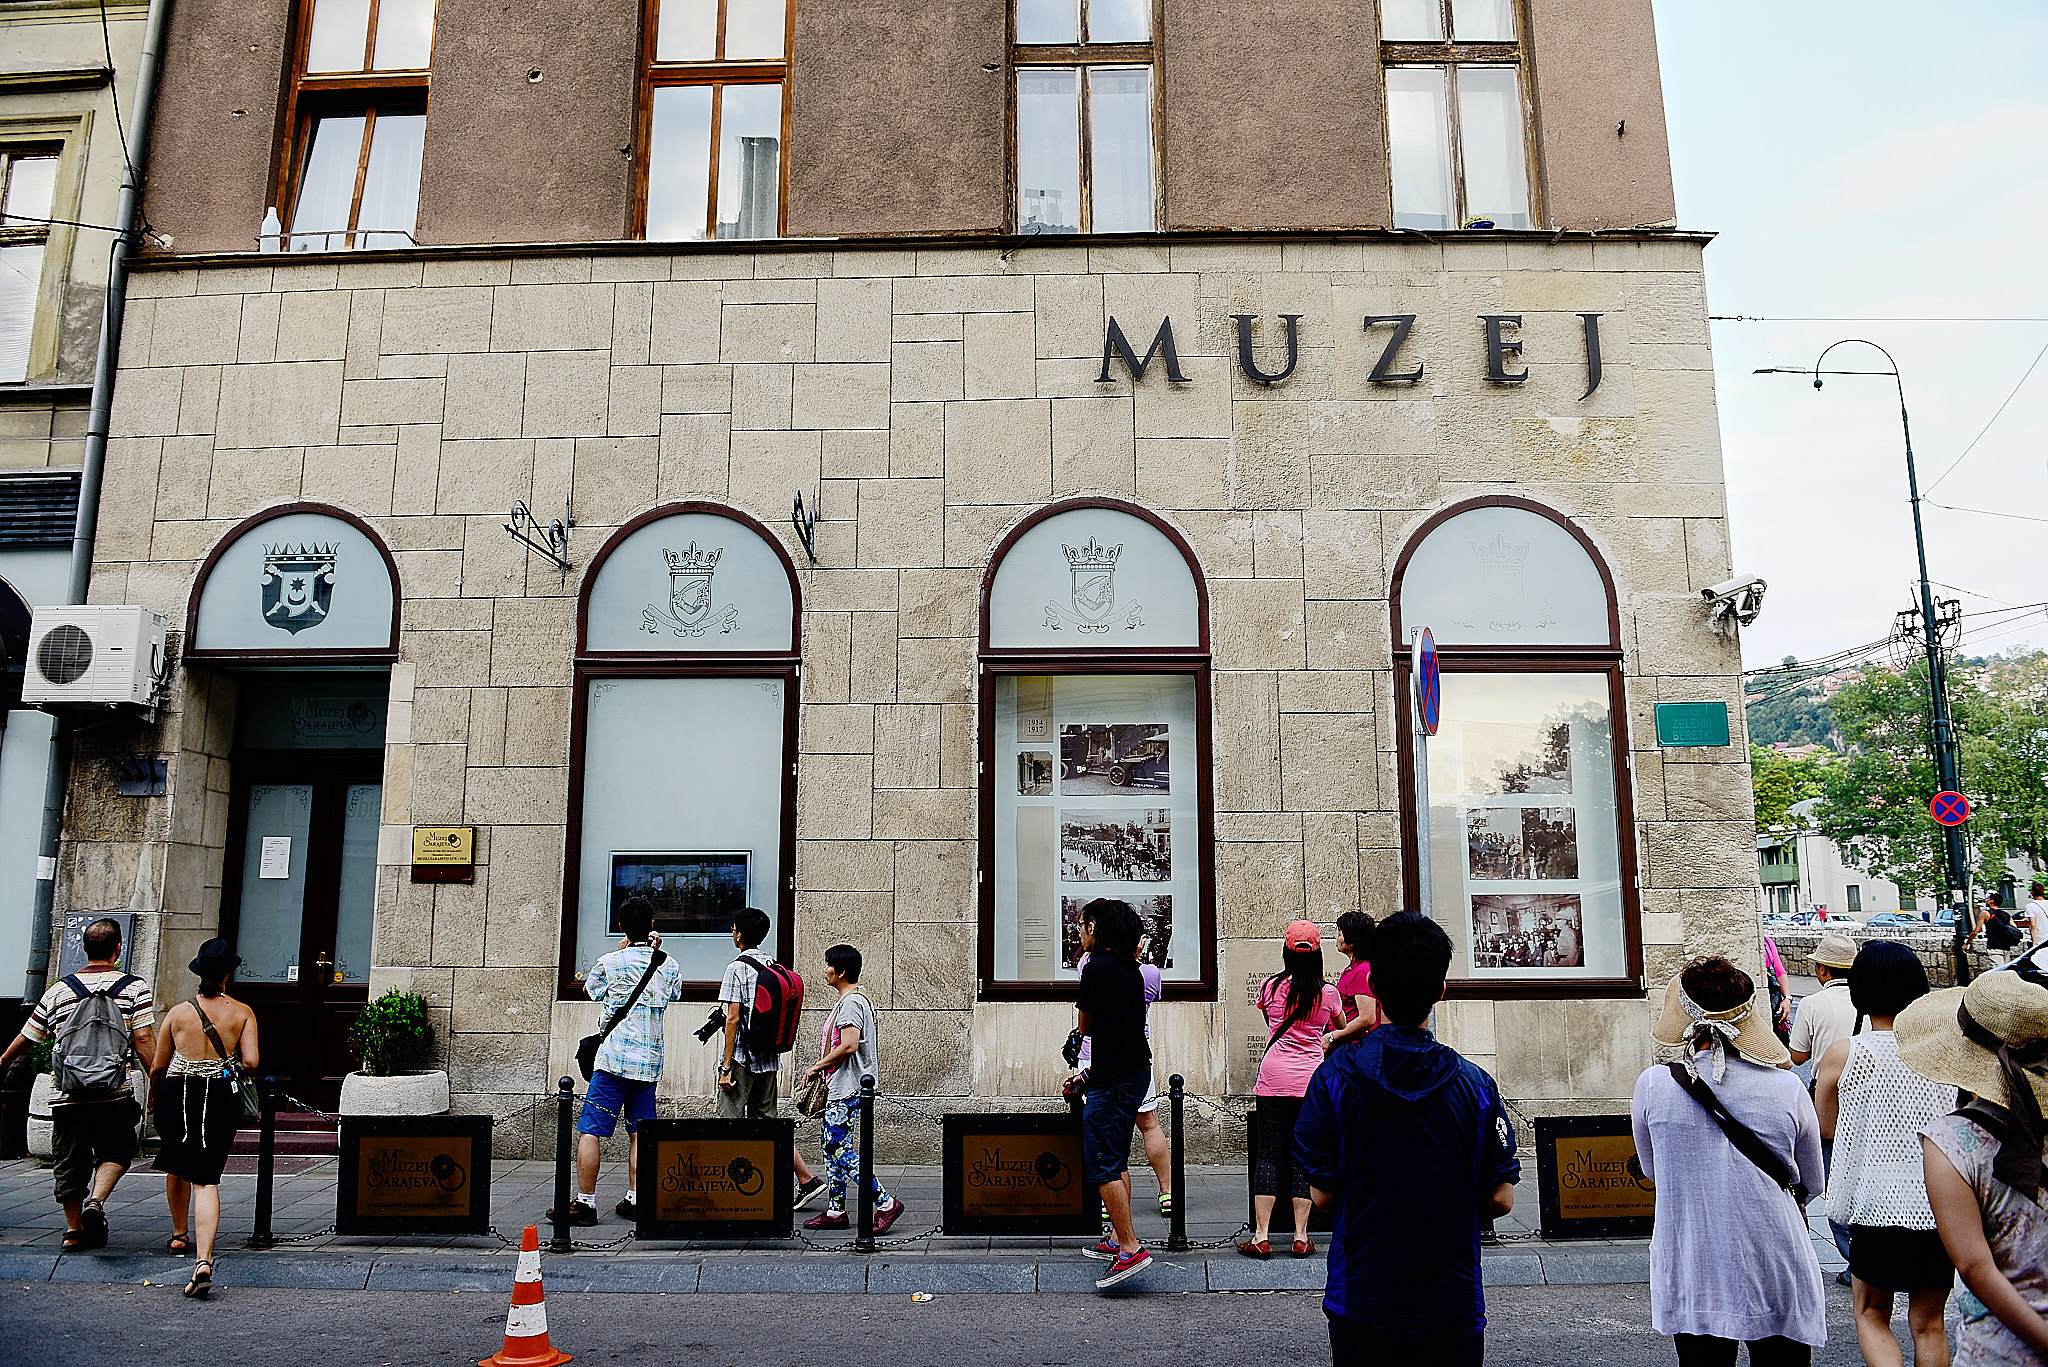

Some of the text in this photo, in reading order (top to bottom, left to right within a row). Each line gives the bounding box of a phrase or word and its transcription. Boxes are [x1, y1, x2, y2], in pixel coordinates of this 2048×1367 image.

[1093, 313, 1605, 402] MUZEJ
[292, 709, 353, 732] SARAJEVA
[307, 697, 346, 719] MUZEJ
[1672, 718, 1712, 729] ZELENIH
[1672, 729, 1714, 741] BERETKI
[380, 1149, 431, 1176] MUZEJ
[675, 1153, 727, 1179] MUZEJ
[982, 1147, 1033, 1175] MUZEJ
[1575, 1149, 1626, 1176] MUZEJ
[365, 1161, 438, 1191] SARAJEVA
[661, 1165, 736, 1195] SARAJEVA
[967, 1160, 1044, 1190] SARAJEVA
[1561, 1162, 1637, 1192] SARAJEVA
